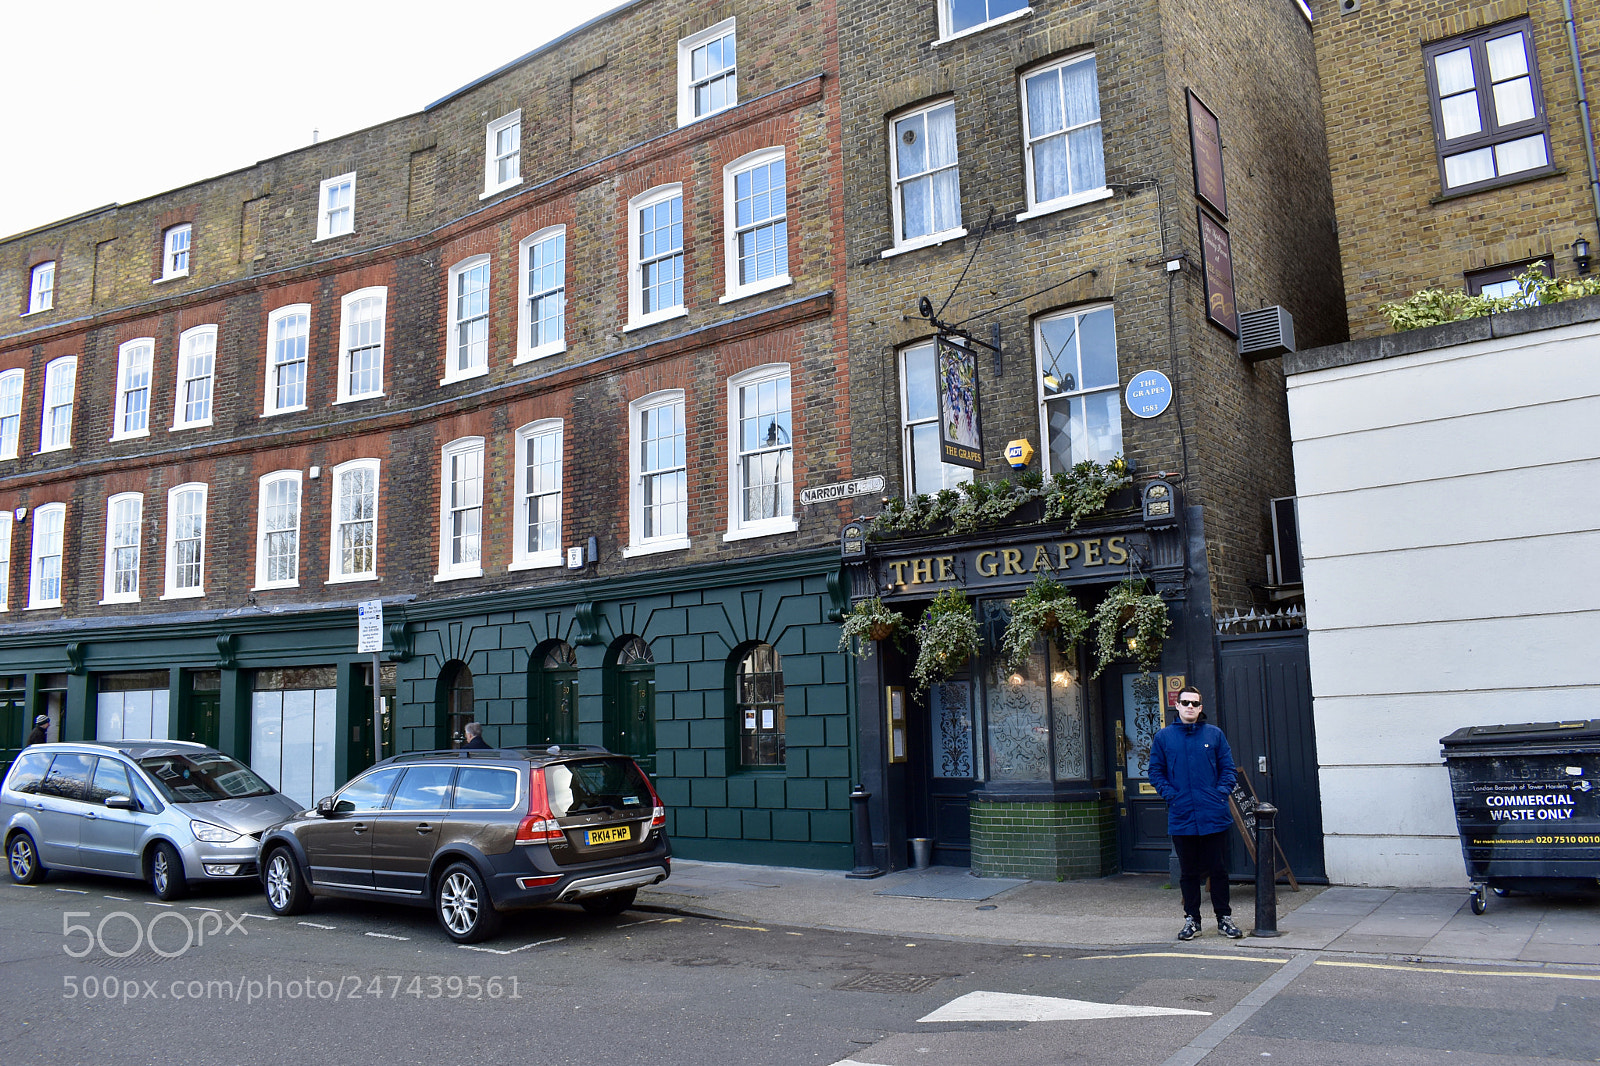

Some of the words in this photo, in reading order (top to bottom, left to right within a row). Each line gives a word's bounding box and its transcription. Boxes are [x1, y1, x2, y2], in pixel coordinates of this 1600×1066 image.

[1139, 379, 1157, 388] THE
[1132, 386, 1165, 398] GRAPES
[1142, 404, 1158, 413] 1583
[945, 445, 958, 457] THE
[958, 448, 982, 463] GRAPES
[1010, 447, 1022, 457] ADT
[804, 484, 845, 502] NARROW
[889, 555, 957, 586] THE
[975, 536, 1129, 577] GRAPES
[1486, 794, 1575, 806] COMMERCIAL
[1490, 809, 1535, 820] WASTE
[1537, 808, 1574, 820] ONLY
[591, 831, 610, 843] RK14
[612, 828, 627, 839] FMP
[1578, 835, 1600, 843] 0010
